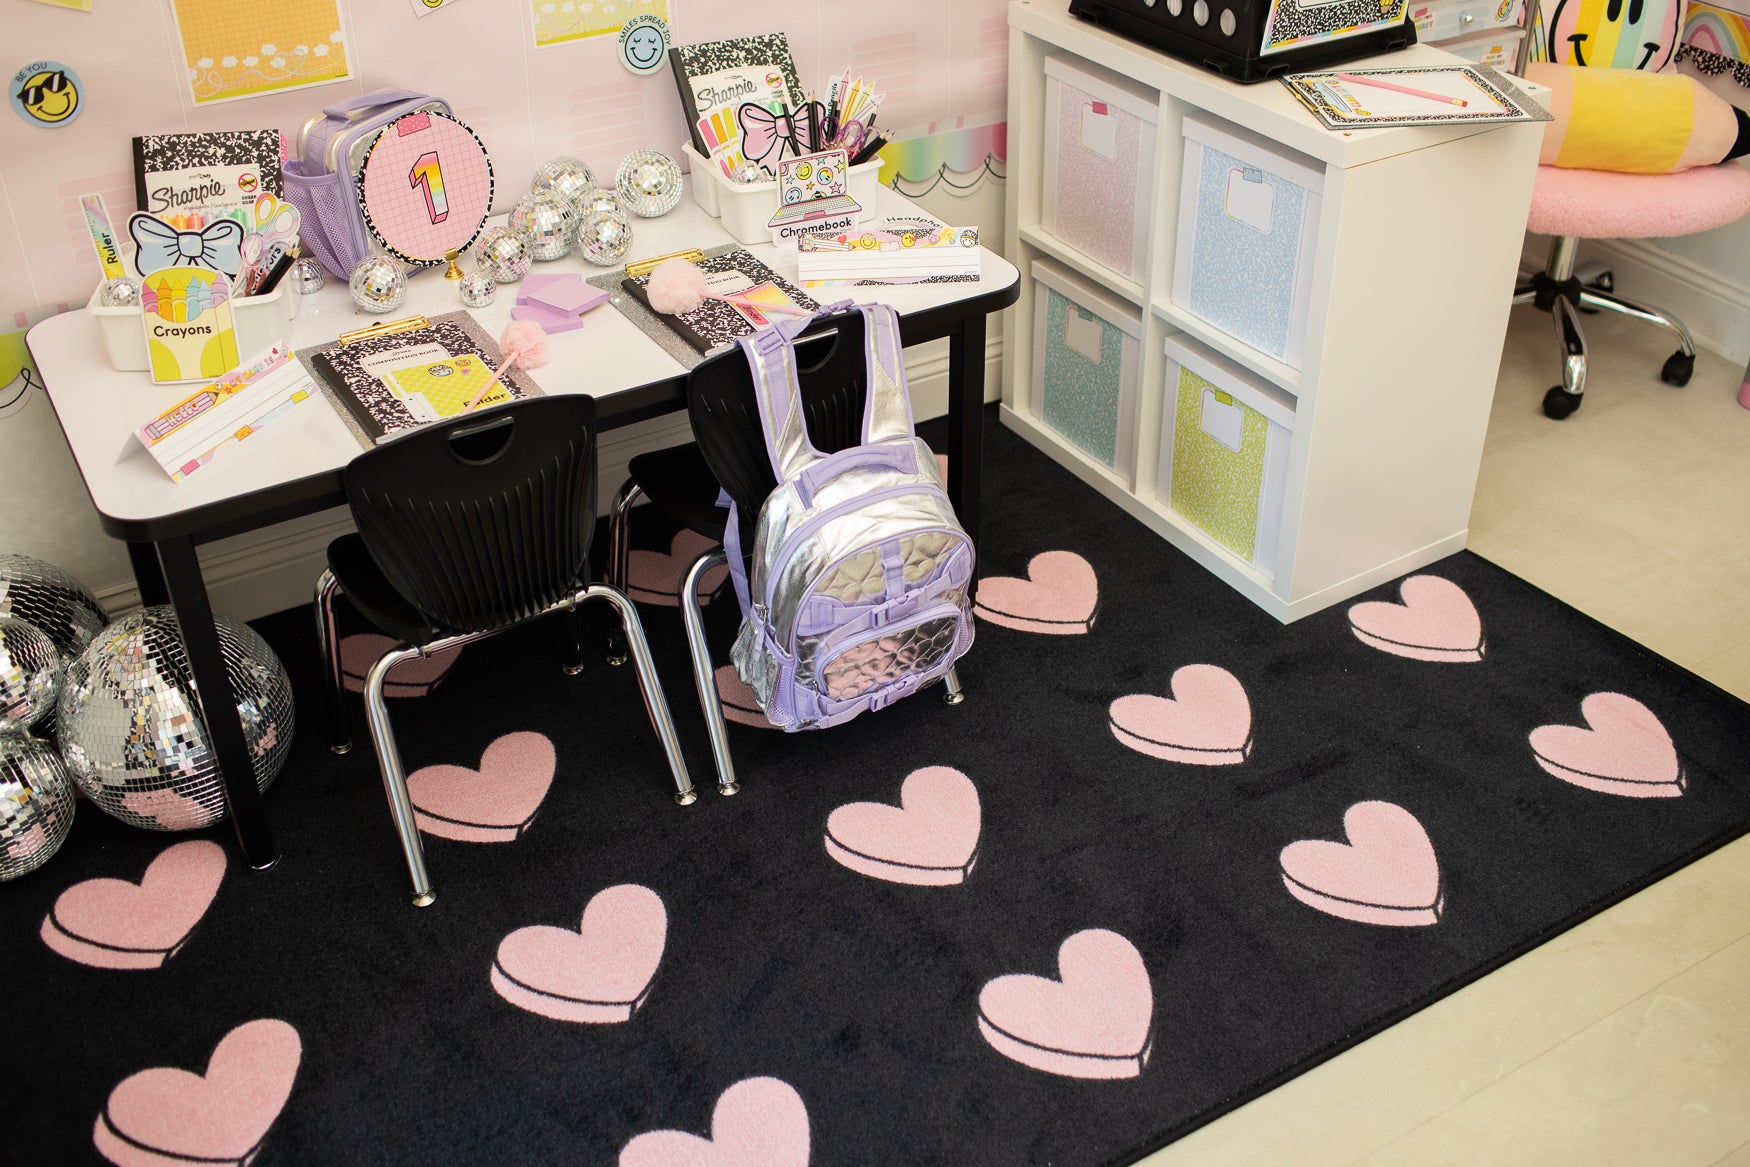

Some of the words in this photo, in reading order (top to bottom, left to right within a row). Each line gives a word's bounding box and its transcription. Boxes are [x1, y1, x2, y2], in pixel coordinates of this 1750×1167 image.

[619, 18, 639, 44] SMILES
[640, 15, 666, 29] SPREAD
[662, 29, 671, 46] JOY
[15, 71, 27, 83] BE
[26, 62, 48, 73] YOU
[697, 78, 757, 112] Sharpie
[150, 178, 226, 214] Sharpie
[408, 151, 449, 225] 1
[780, 217, 852, 239] Chromebook
[886, 216, 943, 228] Headpho
[102, 233, 118, 264] Ruler
[153, 325, 212, 338] Crayons
[463, 393, 506, 407] Flder
